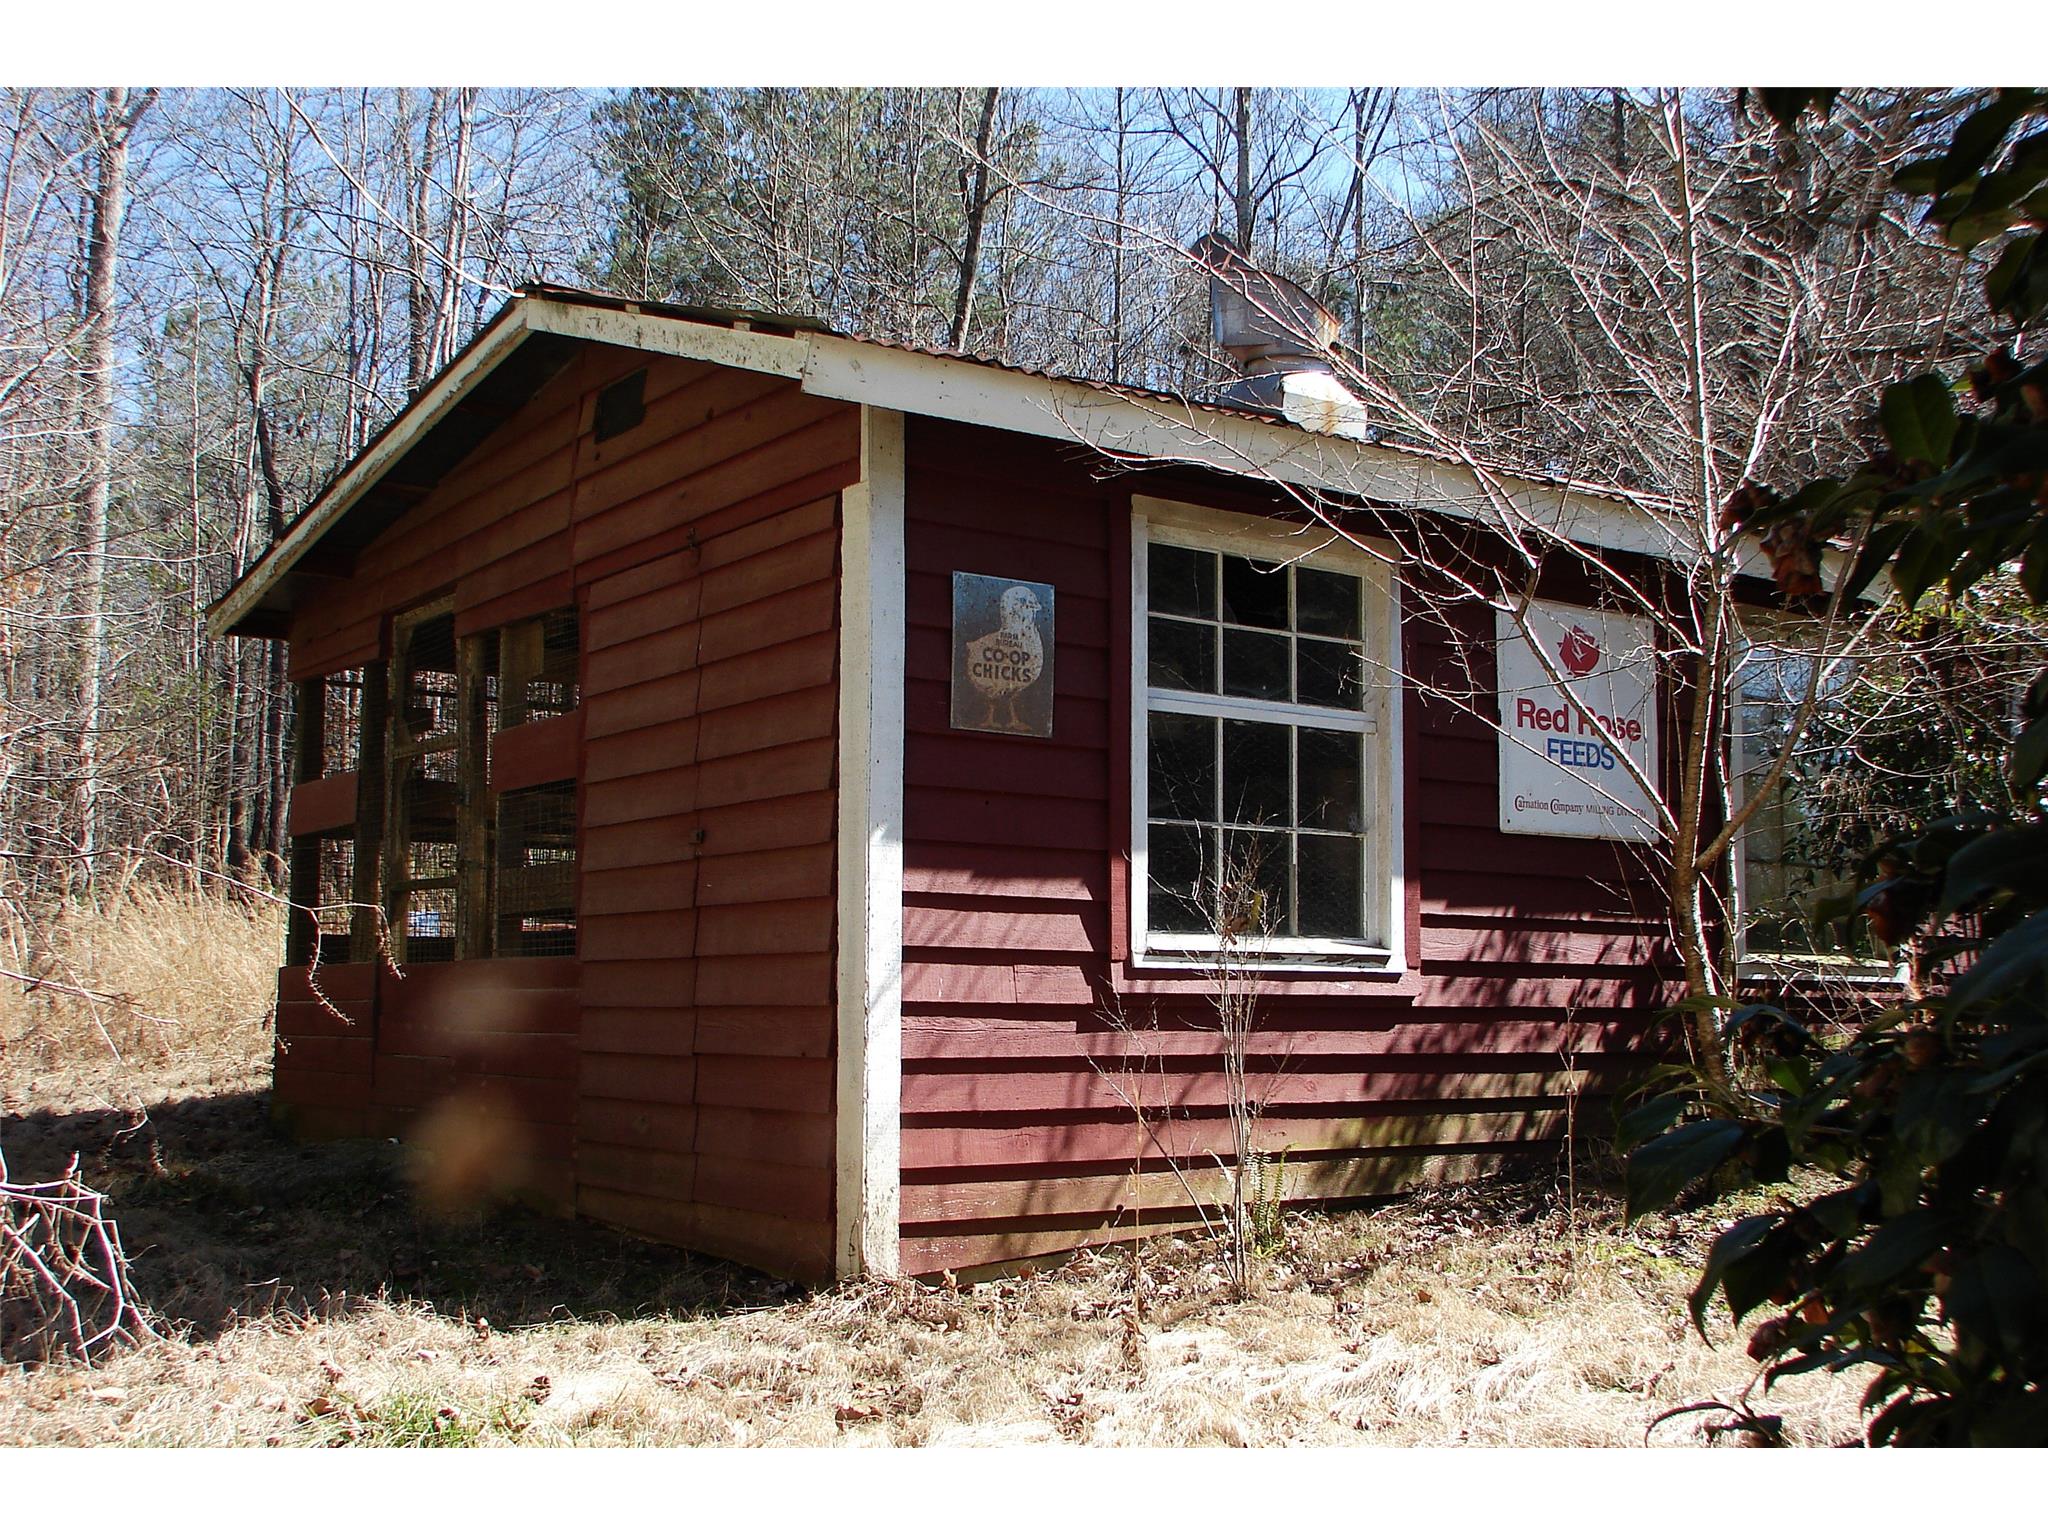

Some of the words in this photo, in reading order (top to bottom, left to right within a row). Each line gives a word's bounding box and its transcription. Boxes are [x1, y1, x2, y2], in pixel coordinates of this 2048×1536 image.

[973, 663, 1031, 682] CHICKS
[1517, 698, 1569, 733] Red
[1547, 738, 1615, 770] FEEDS
[1514, 795, 1549, 812] Carnation
[1550, 798, 1584, 815] Company
